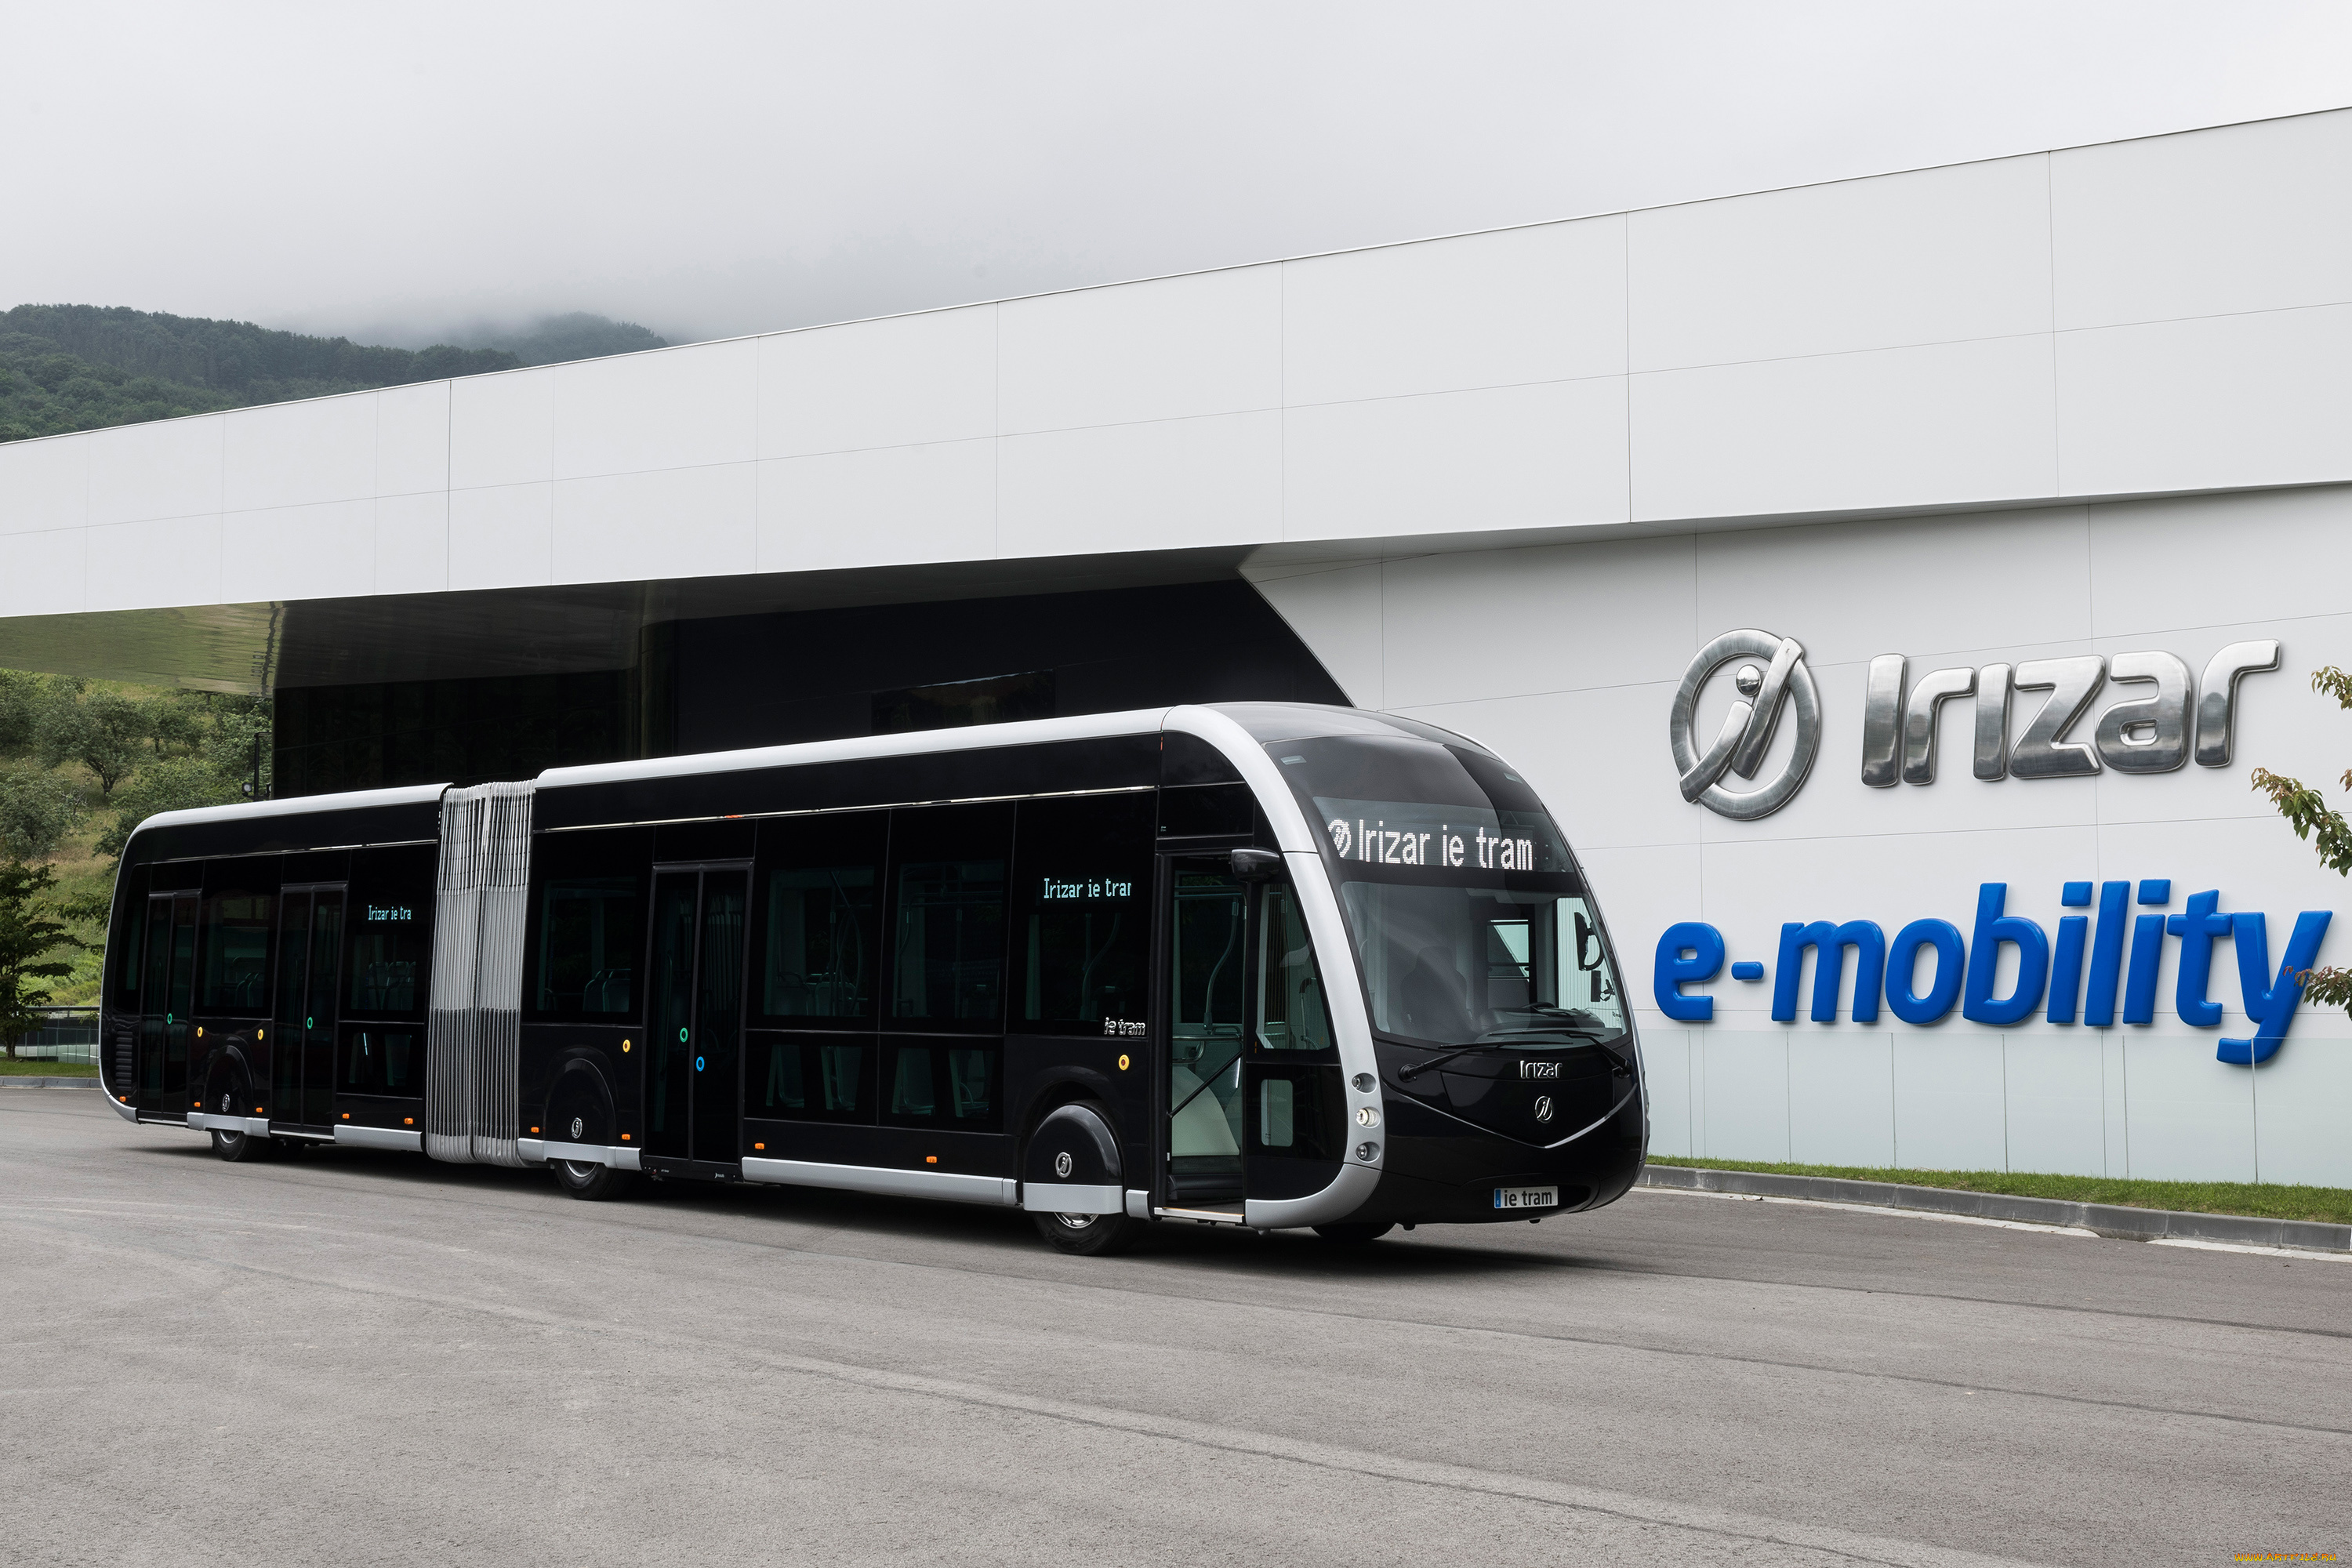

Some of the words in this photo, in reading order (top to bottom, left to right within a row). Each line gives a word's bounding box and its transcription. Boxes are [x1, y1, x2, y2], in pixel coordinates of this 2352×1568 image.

[1861, 638, 2281, 787] Irizar
[1359, 819, 1431, 865] Irizar
[1443, 825, 1465, 867] ie
[1476, 826, 1533, 870] tram
[1044, 877, 1083, 898] Irizar
[1088, 878, 1101, 898] ie
[368, 905, 390, 920] Irizar
[390, 906, 398, 920] ie
[1653, 878, 2334, 1065] e-mobility
[1104, 1016, 1116, 1035] ie
[1117, 1018, 1145, 1036] tram
[1519, 1060, 1563, 1079] Irizar
[1504, 1189, 1517, 1207] ie
[1521, 1190, 1552, 1206] tram
